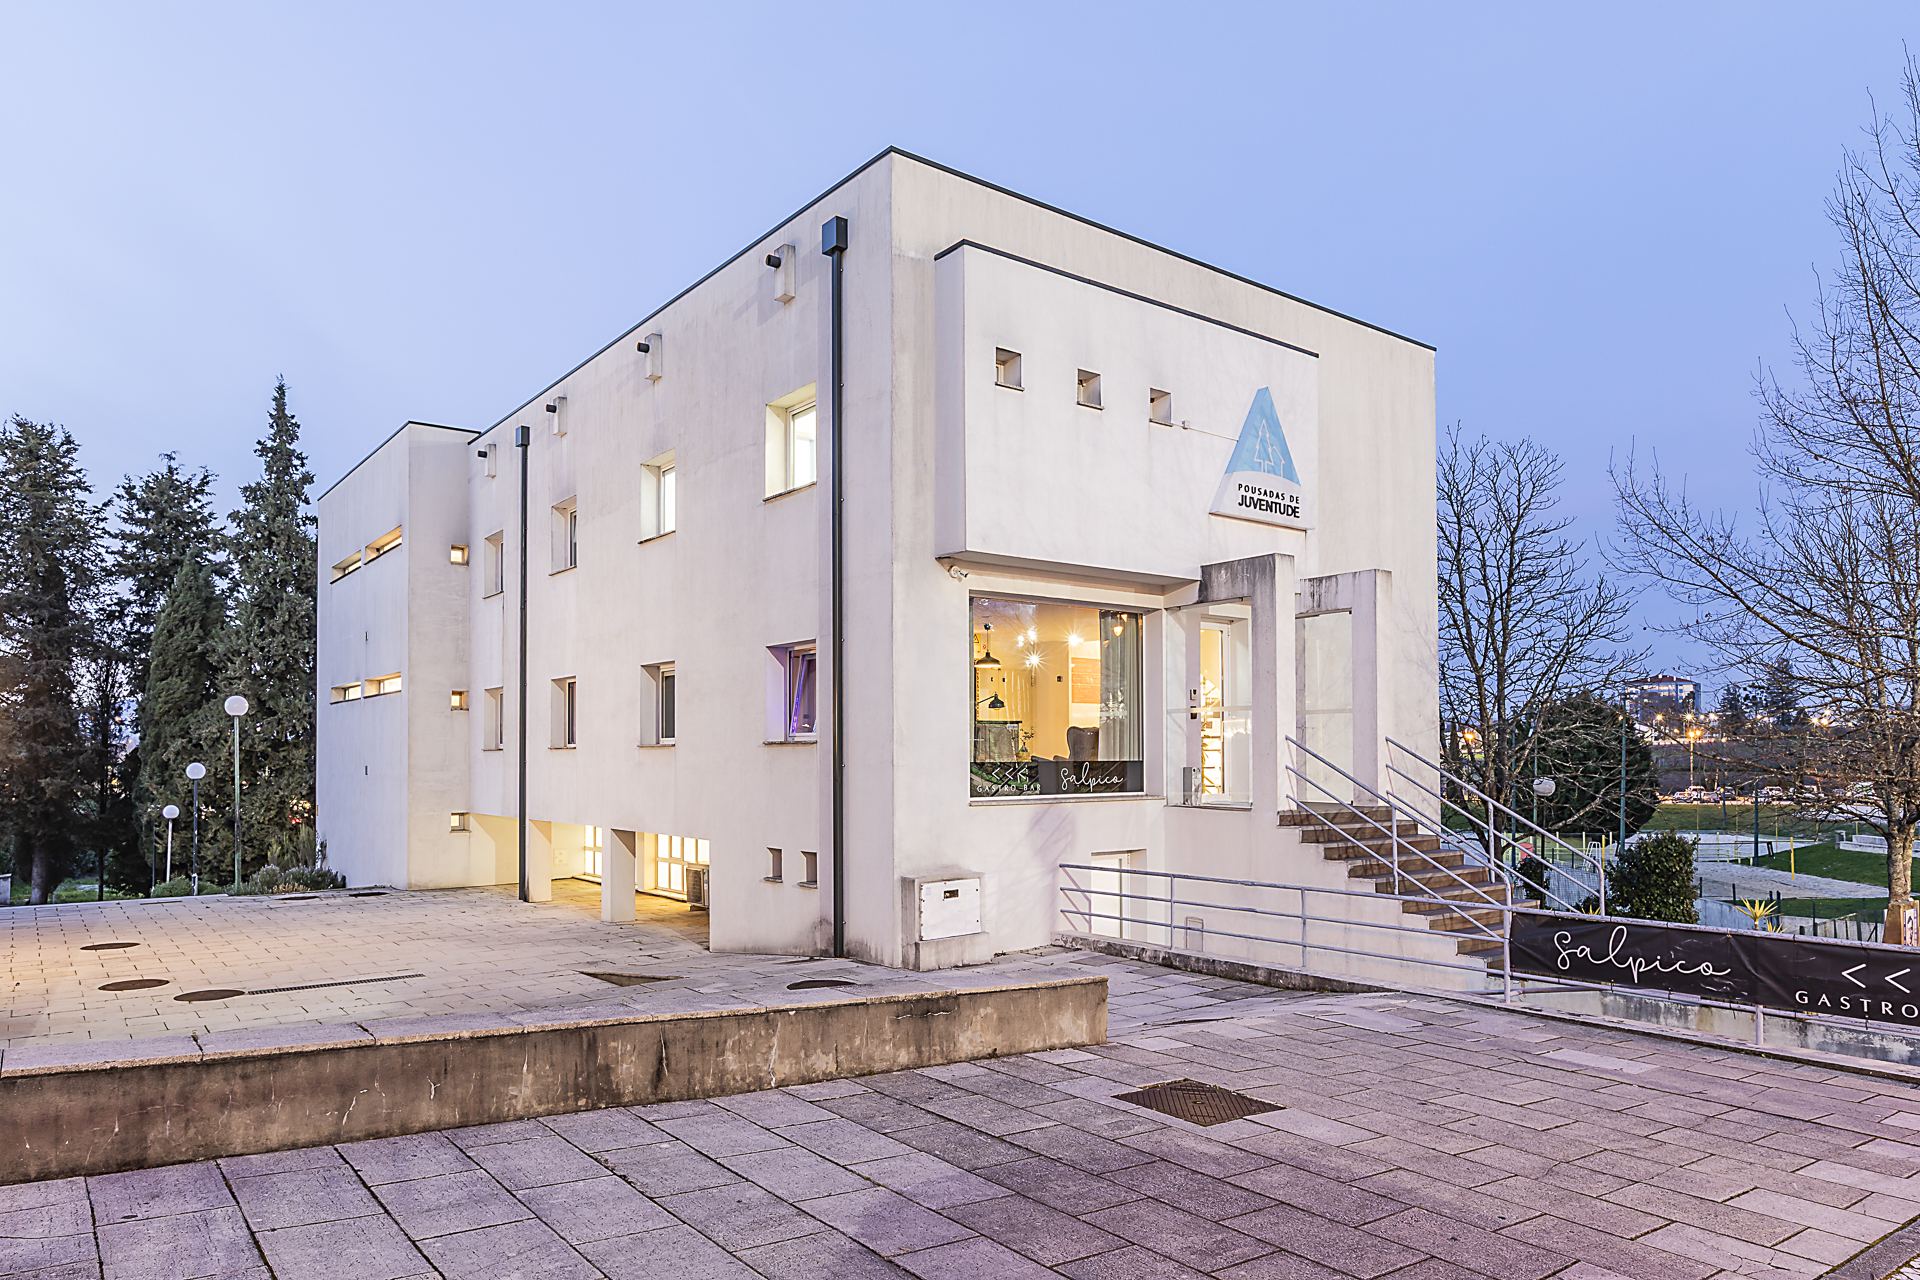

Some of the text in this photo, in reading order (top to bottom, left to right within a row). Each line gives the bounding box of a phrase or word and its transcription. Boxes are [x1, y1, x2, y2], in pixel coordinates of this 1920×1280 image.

[1238, 483, 1299, 504] POUSADAS DE
[1238, 495, 1300, 518] JUVENTUDE
[976, 784, 1016, 793] GASTRO
[1060, 761, 1124, 792] Salpico
[1553, 925, 1732, 984] Salpico
[1795, 990, 1919, 1018] GASTRO
